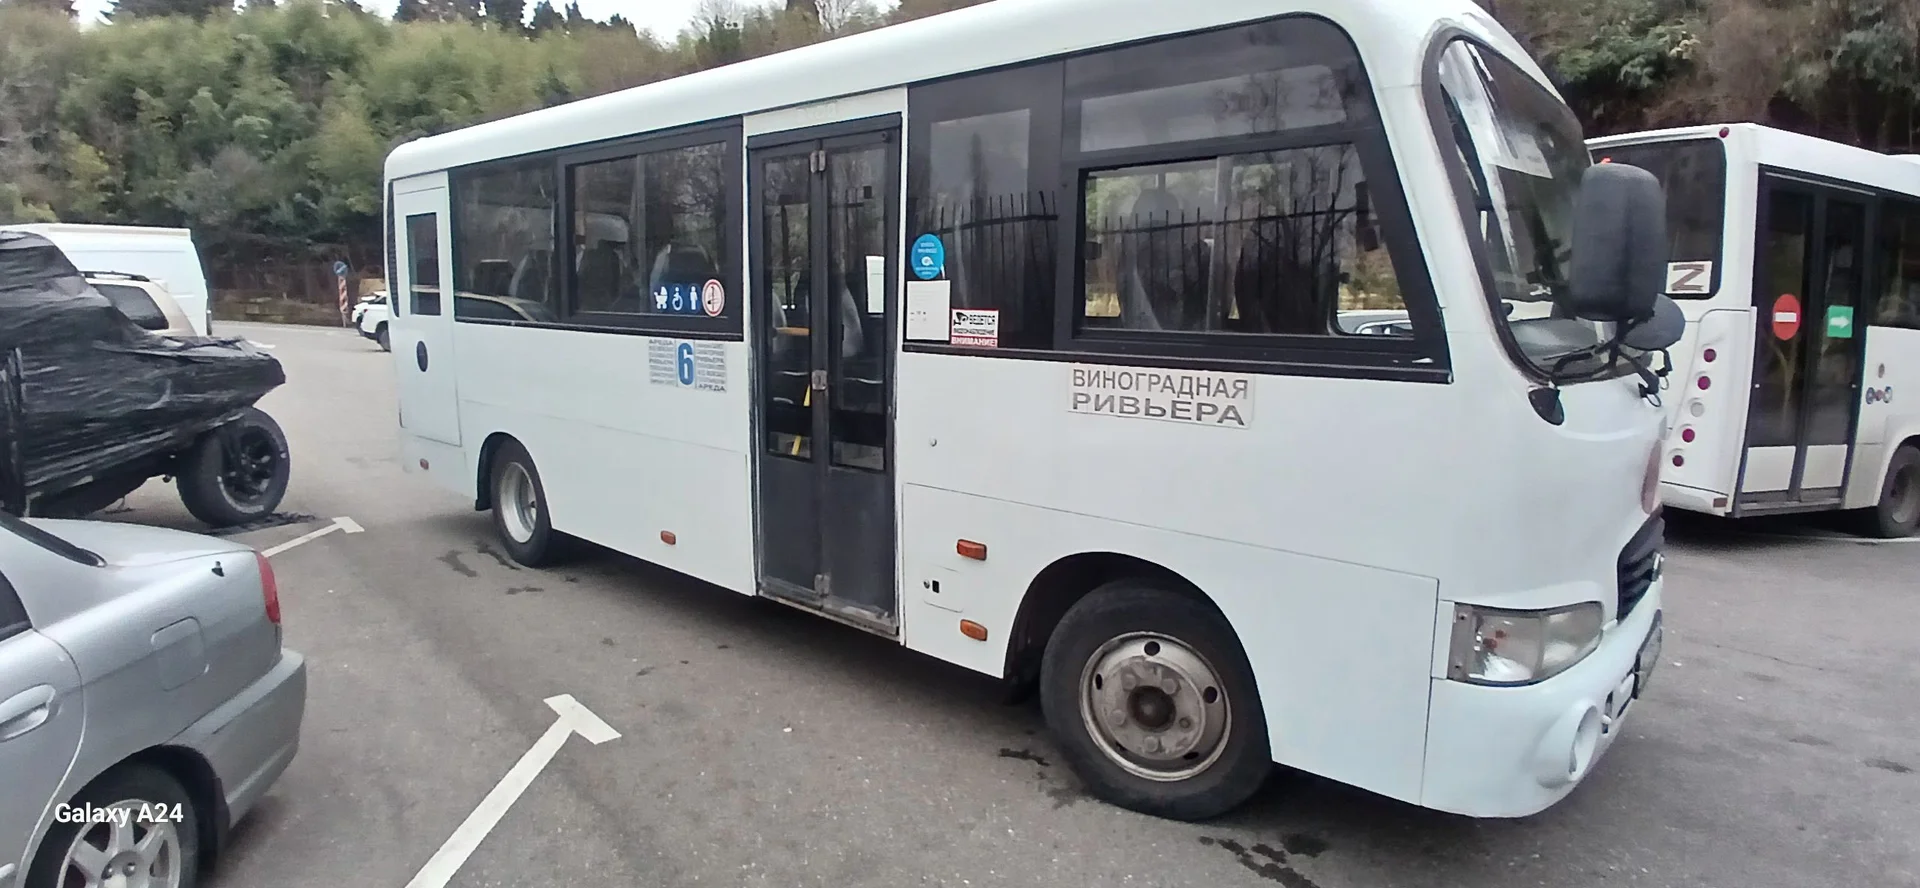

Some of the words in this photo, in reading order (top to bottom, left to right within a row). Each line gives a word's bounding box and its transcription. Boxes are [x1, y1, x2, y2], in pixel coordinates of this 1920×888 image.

[1670, 264, 1705, 291] Z
[952, 337, 997, 347] ВНИМАНИЕ!
[678, 343, 694, 385] 6
[1073, 369, 1248, 399] ВИНОГРАДНАЯ
[1073, 393, 1245, 426] РИВЬЕРА
